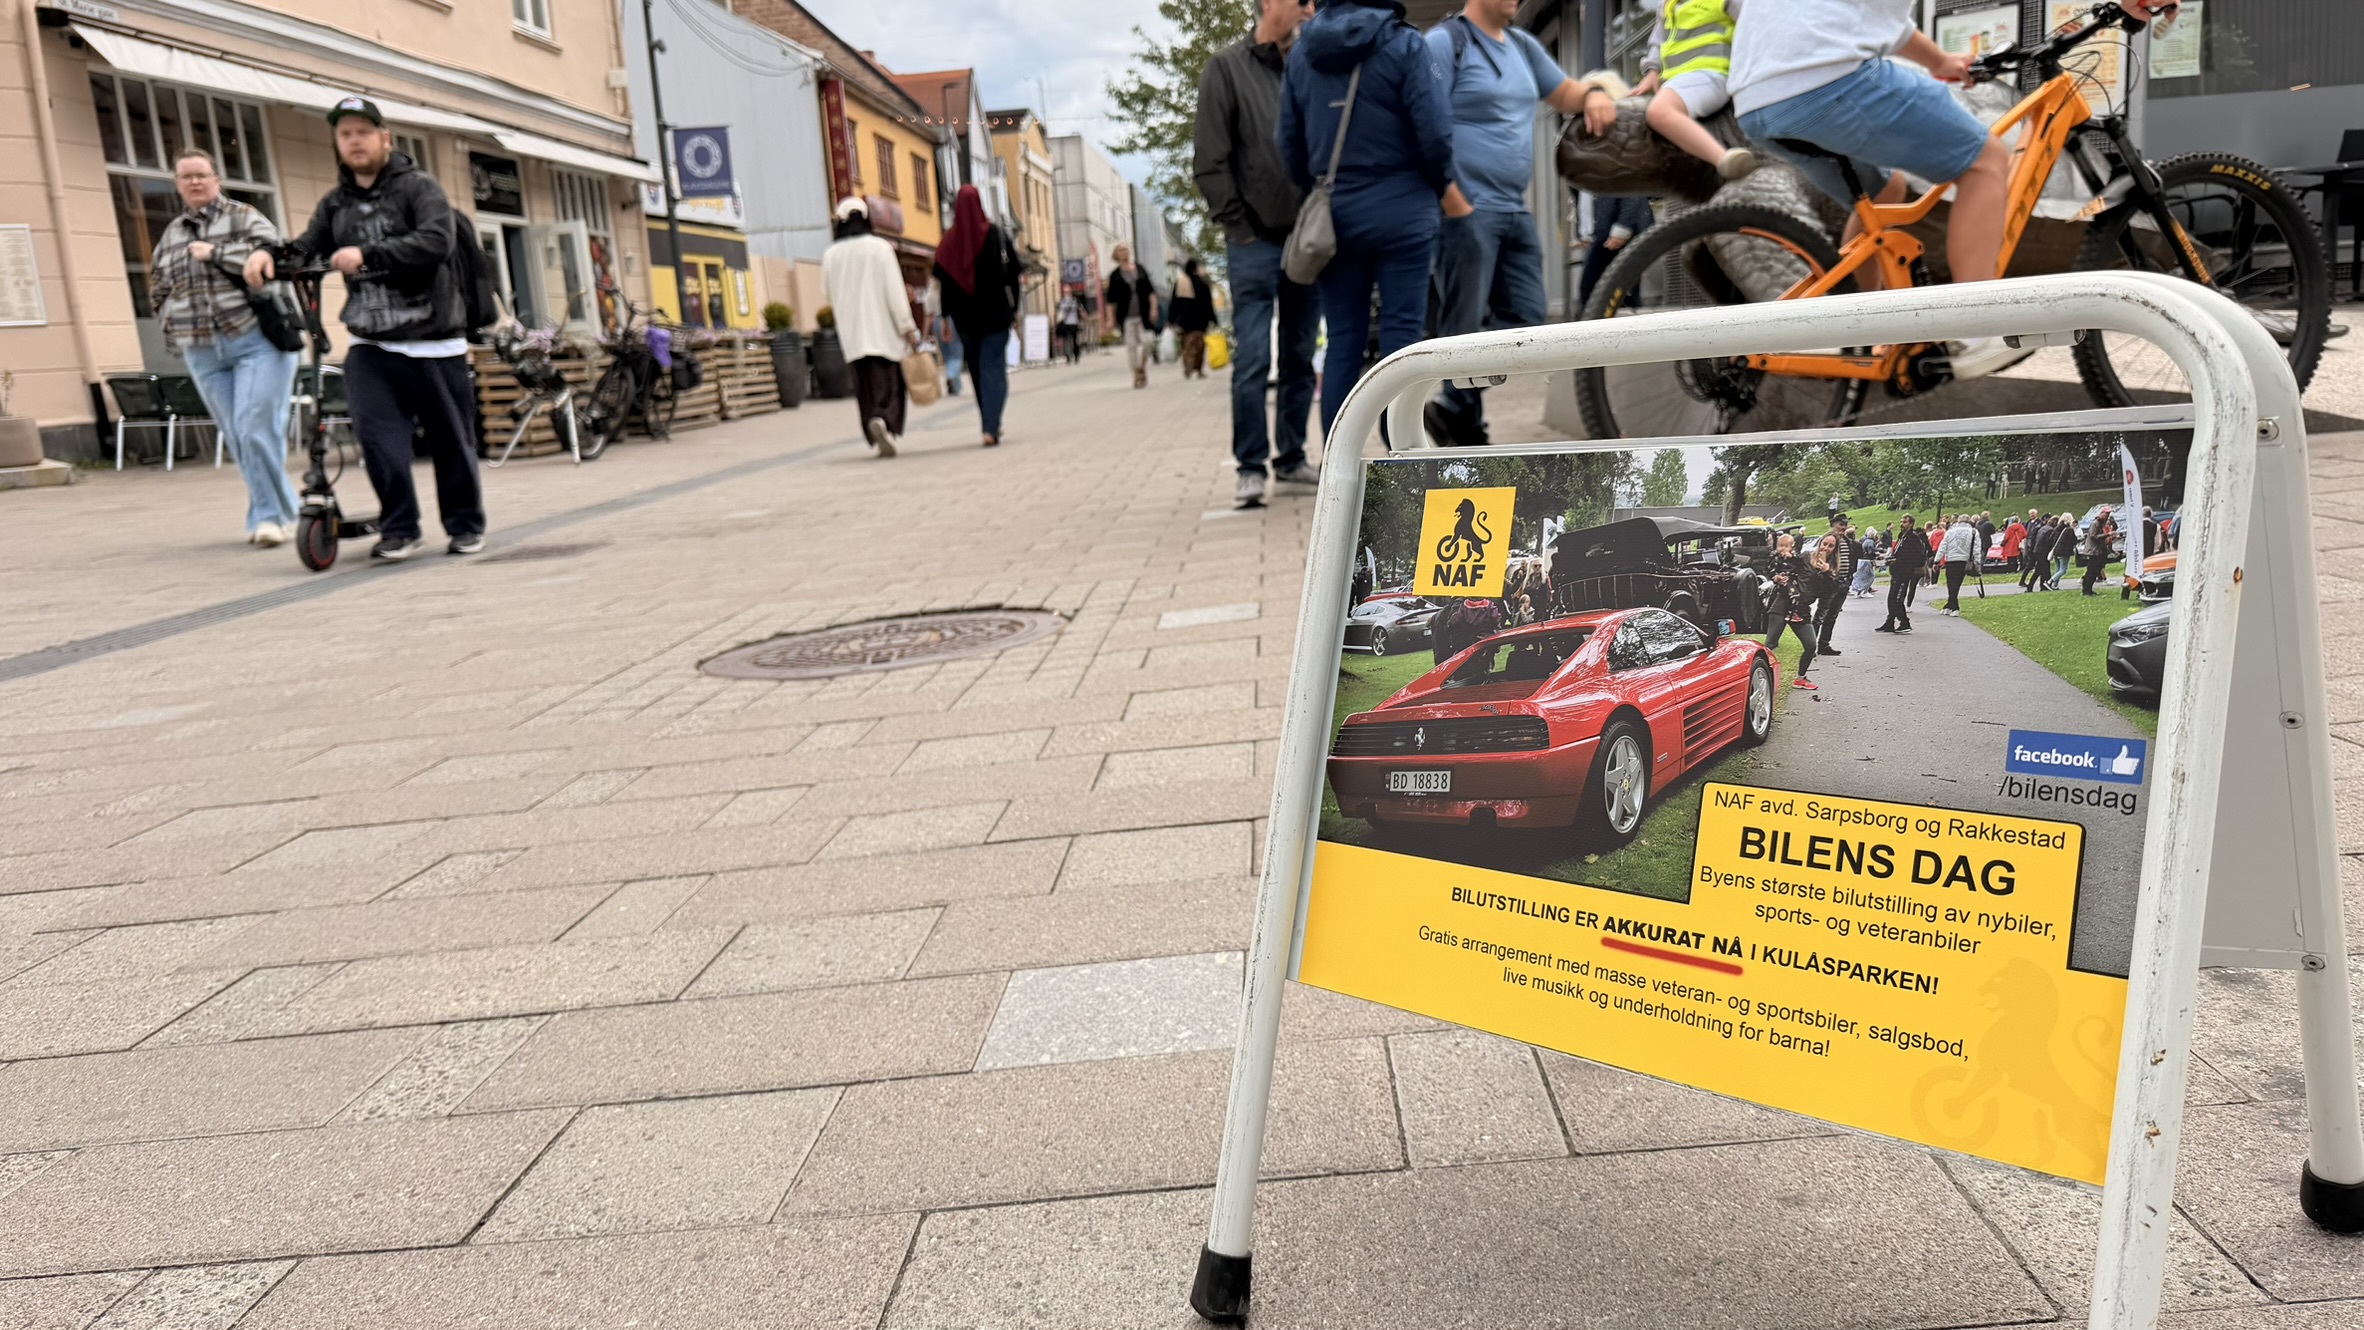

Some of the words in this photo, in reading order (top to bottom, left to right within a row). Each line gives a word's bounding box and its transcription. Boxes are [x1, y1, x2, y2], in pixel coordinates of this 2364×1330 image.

[2210, 164, 2272, 190] MAXXIS
[1432, 564, 1486, 587] NAF
[1393, 773, 1408, 789] BD
[1413, 773, 1448, 790] 18838
[1998, 776, 2137, 815] /bilensdag
[1715, 790, 1755, 810] NAF
[1760, 799, 1798, 817] avd.
[1805, 801, 1908, 835] Sarpsborg
[1915, 818, 1941, 838] og
[1948, 818, 2066, 850] Rakkestad
[1739, 826, 1896, 879] BILENS
[1911, 849, 2016, 896] DAG
[1700, 865, 1755, 889] Byens
[1761, 877, 1826, 901] største
[1832, 886, 1938, 923] bilutstilling
[1944, 907, 1971, 924] av
[1977, 911, 2056, 942] nybiler,
[1755, 904, 1820, 925] sports-
[1826, 916, 1850, 937] og
[1857, 921, 1981, 954] veteranbiler
[1451, 886, 1570, 923] BILUTSTILLING
[1575, 910, 1599, 930] ER
[1602, 916, 1706, 950] AKKURAT
[1711, 936, 1743, 958] NÅ
[1750, 943, 1757, 961] I
[1762, 945, 1939, 995] KULÅSPARKEN!
[1418, 925, 1458, 947] Gratis
[1461, 937, 1553, 968] arrangement
[1556, 958, 1590, 977] med
[1594, 966, 1647, 989] masse
[1652, 979, 1723, 1005] veteran-
[1727, 995, 1751, 1016] og
[1756, 1001, 1861, 1040] sportsbiler,
[1868, 1025, 1969, 1063] salgsbod,
[1503, 966, 1528, 986] live
[1532, 976, 1585, 1001] musikk
[1589, 990, 1609, 1010] og
[1613, 995, 1733, 1039] underholdning
[1738, 1021, 1764, 1043] for
[1769, 1026, 1831, 1058] barna!
